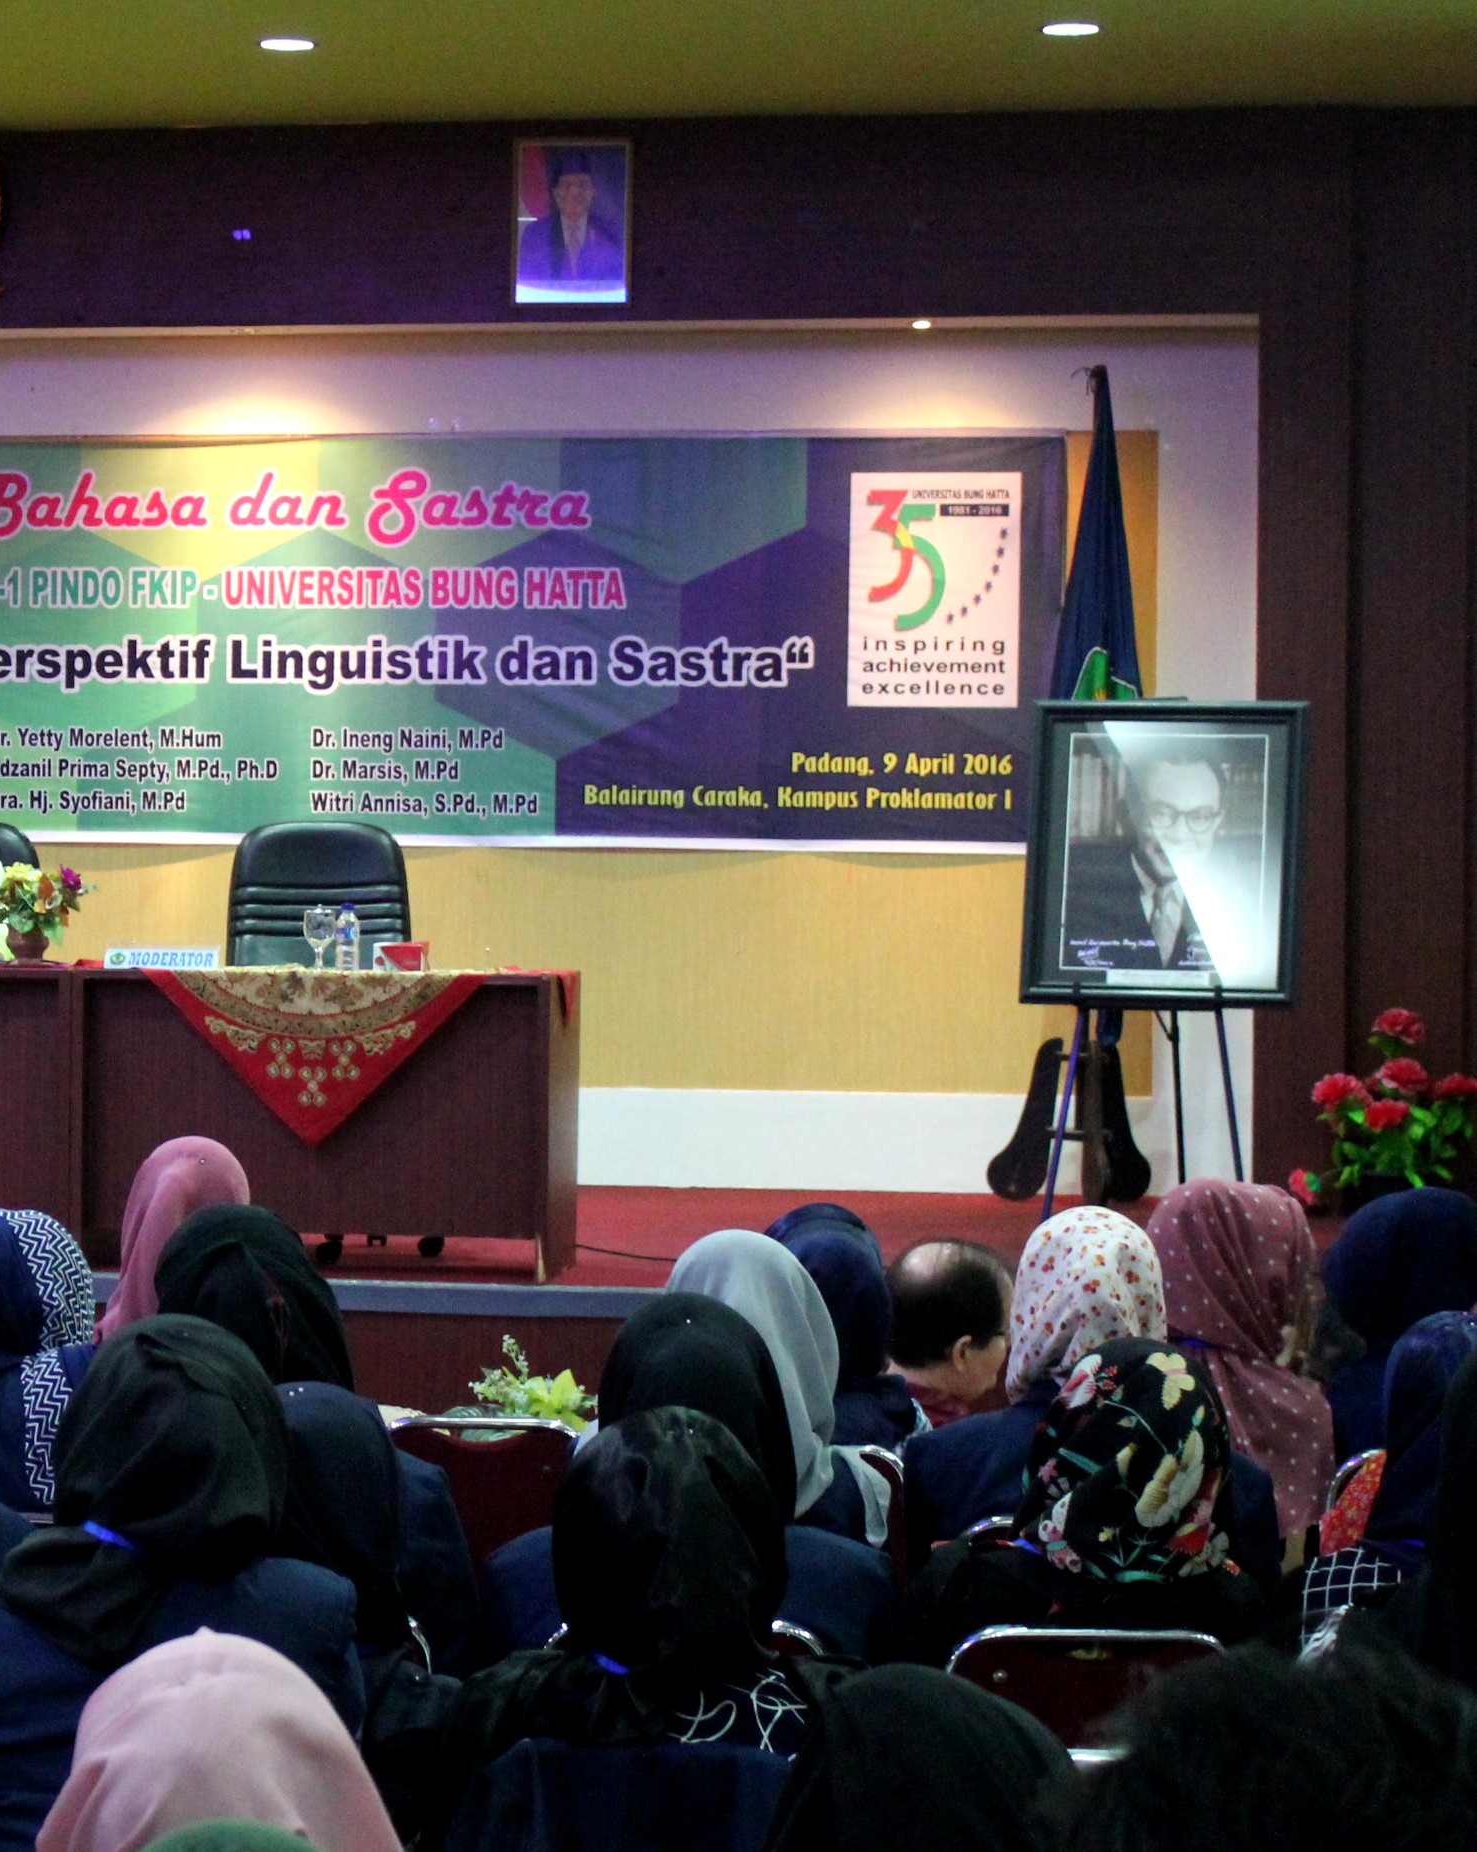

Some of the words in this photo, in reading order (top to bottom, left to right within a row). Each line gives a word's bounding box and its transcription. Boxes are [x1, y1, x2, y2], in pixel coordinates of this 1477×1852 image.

[912, 489, 962, 499] UNIVERSITAS
[964, 489, 984, 499] BUNG
[986, 489, 1009, 499] HATTA
[229, 472, 346, 526] dan
[367, 470, 589, 545] Sastra
[948, 505, 970, 515] 1981
[978, 505, 1003, 515] 2016
[32, 570, 121, 606] PINDO
[132, 570, 197, 606] FKIP
[225, 570, 421, 606] UNIVERSITAS
[432, 570, 516, 606] BUNG
[527, 570, 625, 607] HATTA
[863, 636, 1006, 655] inspiring
[231, 639, 482, 690] Linguistik
[500, 640, 593, 681] dan
[862, 658, 1006, 674] achievement
[862, 680, 1005, 695] excellence
[18, 728, 63, 751] Yetty
[69, 728, 154, 751] Morelent,
[160, 729, 222, 748] M.Hum
[311, 728, 336, 748] Dr.
[342, 729, 393, 752] Ineng
[399, 729, 453, 752] Naini,
[458, 730, 504, 749] M.Pd
[58, 759, 109, 778] Prima
[115, 759, 170, 782] Septy,
[176, 760, 231, 783] M.Pd.,
[237, 760, 278, 779] Ph.D
[311, 760, 336, 779] Dr.
[342, 760, 408, 783] Marsis,
[414, 760, 459, 780] M.Pd
[882, 752, 899, 773] 9
[905, 752, 955, 777] April
[963, 753, 1013, 775] 2016
[29, 789, 53, 813] Hj.
[59, 790, 135, 814] Syofiani,
[141, 791, 186, 810] M.Pd
[311, 792, 355, 812] Witri
[360, 793, 429, 817] Annisa,
[434, 793, 487, 817] S.Pd.,
[492, 794, 539, 814] M.Pd
[583, 784, 685, 809] Balairung
[777, 785, 859, 811] Kampus
[865, 787, 997, 810] Proklamator
[128, 951, 214, 967] MODERATOR
